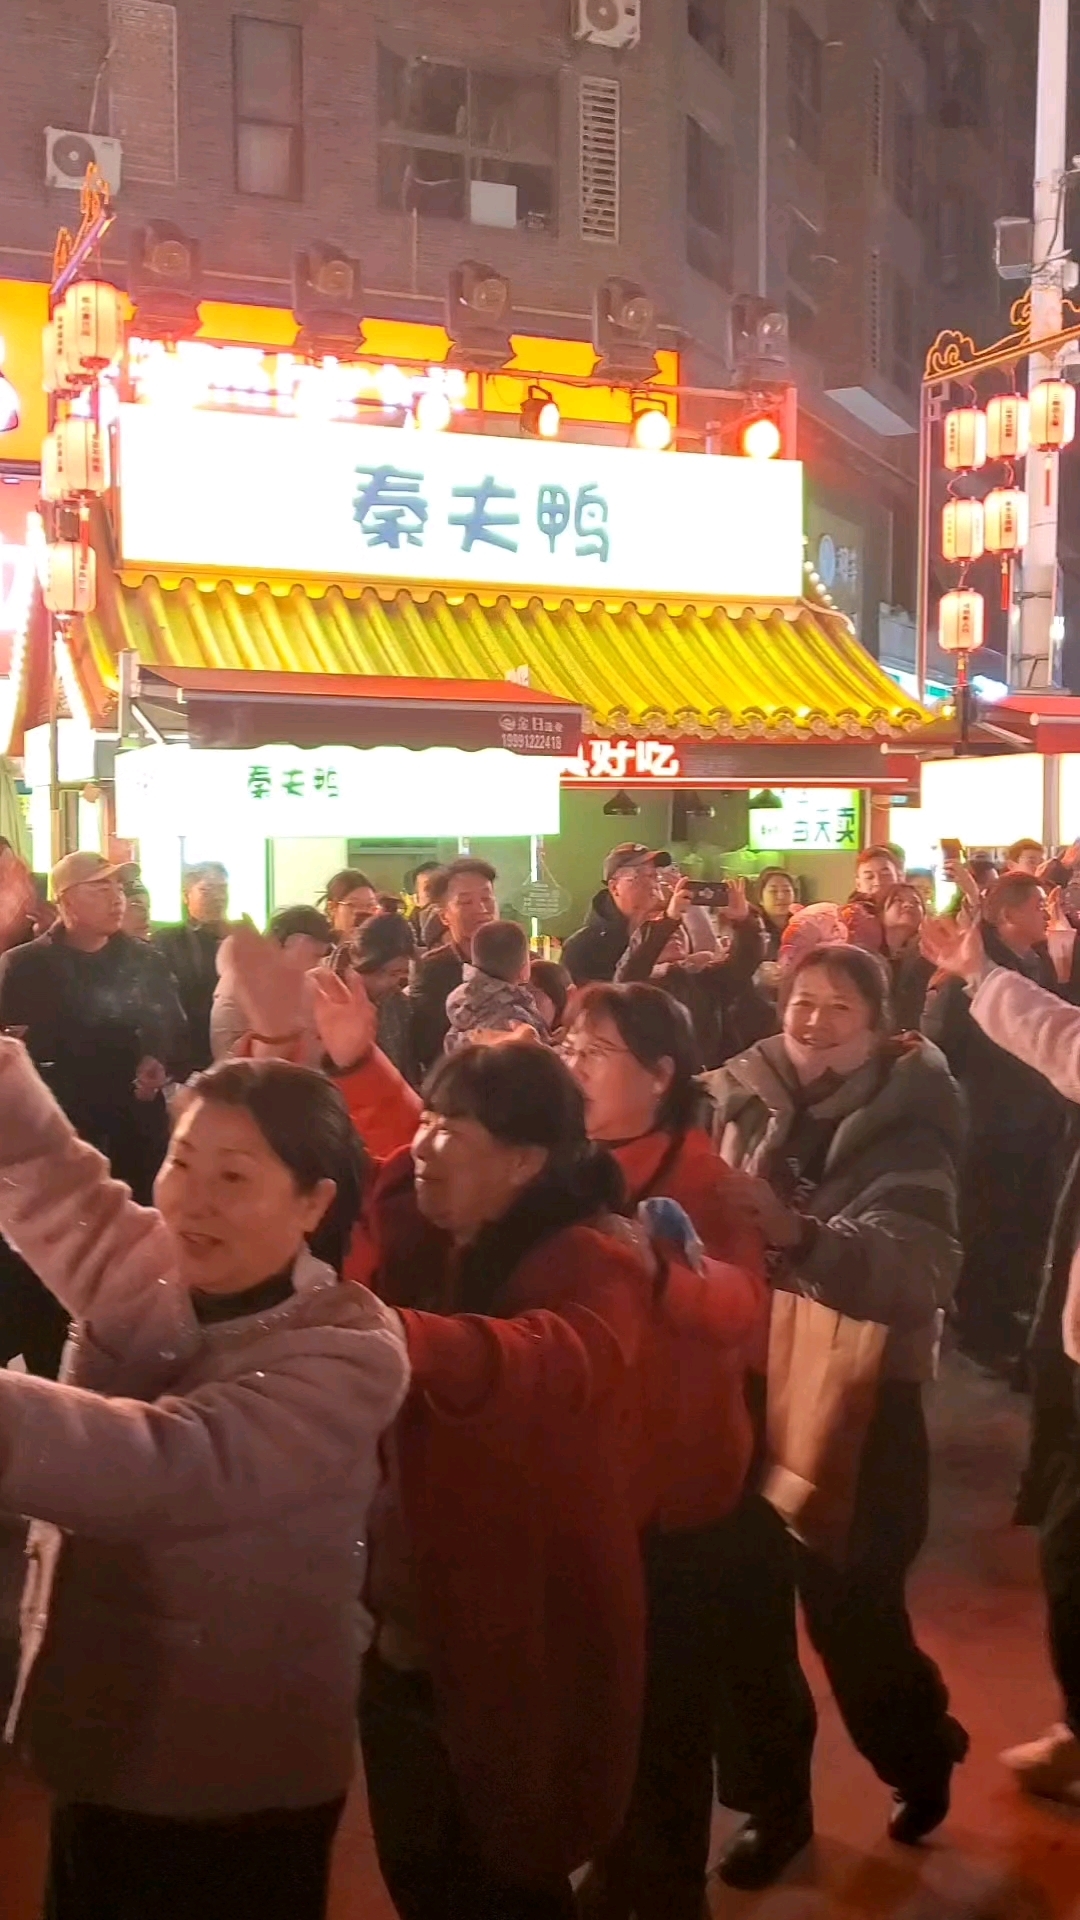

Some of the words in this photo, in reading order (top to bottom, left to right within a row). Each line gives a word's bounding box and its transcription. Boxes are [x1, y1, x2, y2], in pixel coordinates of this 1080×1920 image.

[352, 463, 610, 562] 秦夫鸭
[247, 763, 340, 800] 秦夫鸭
